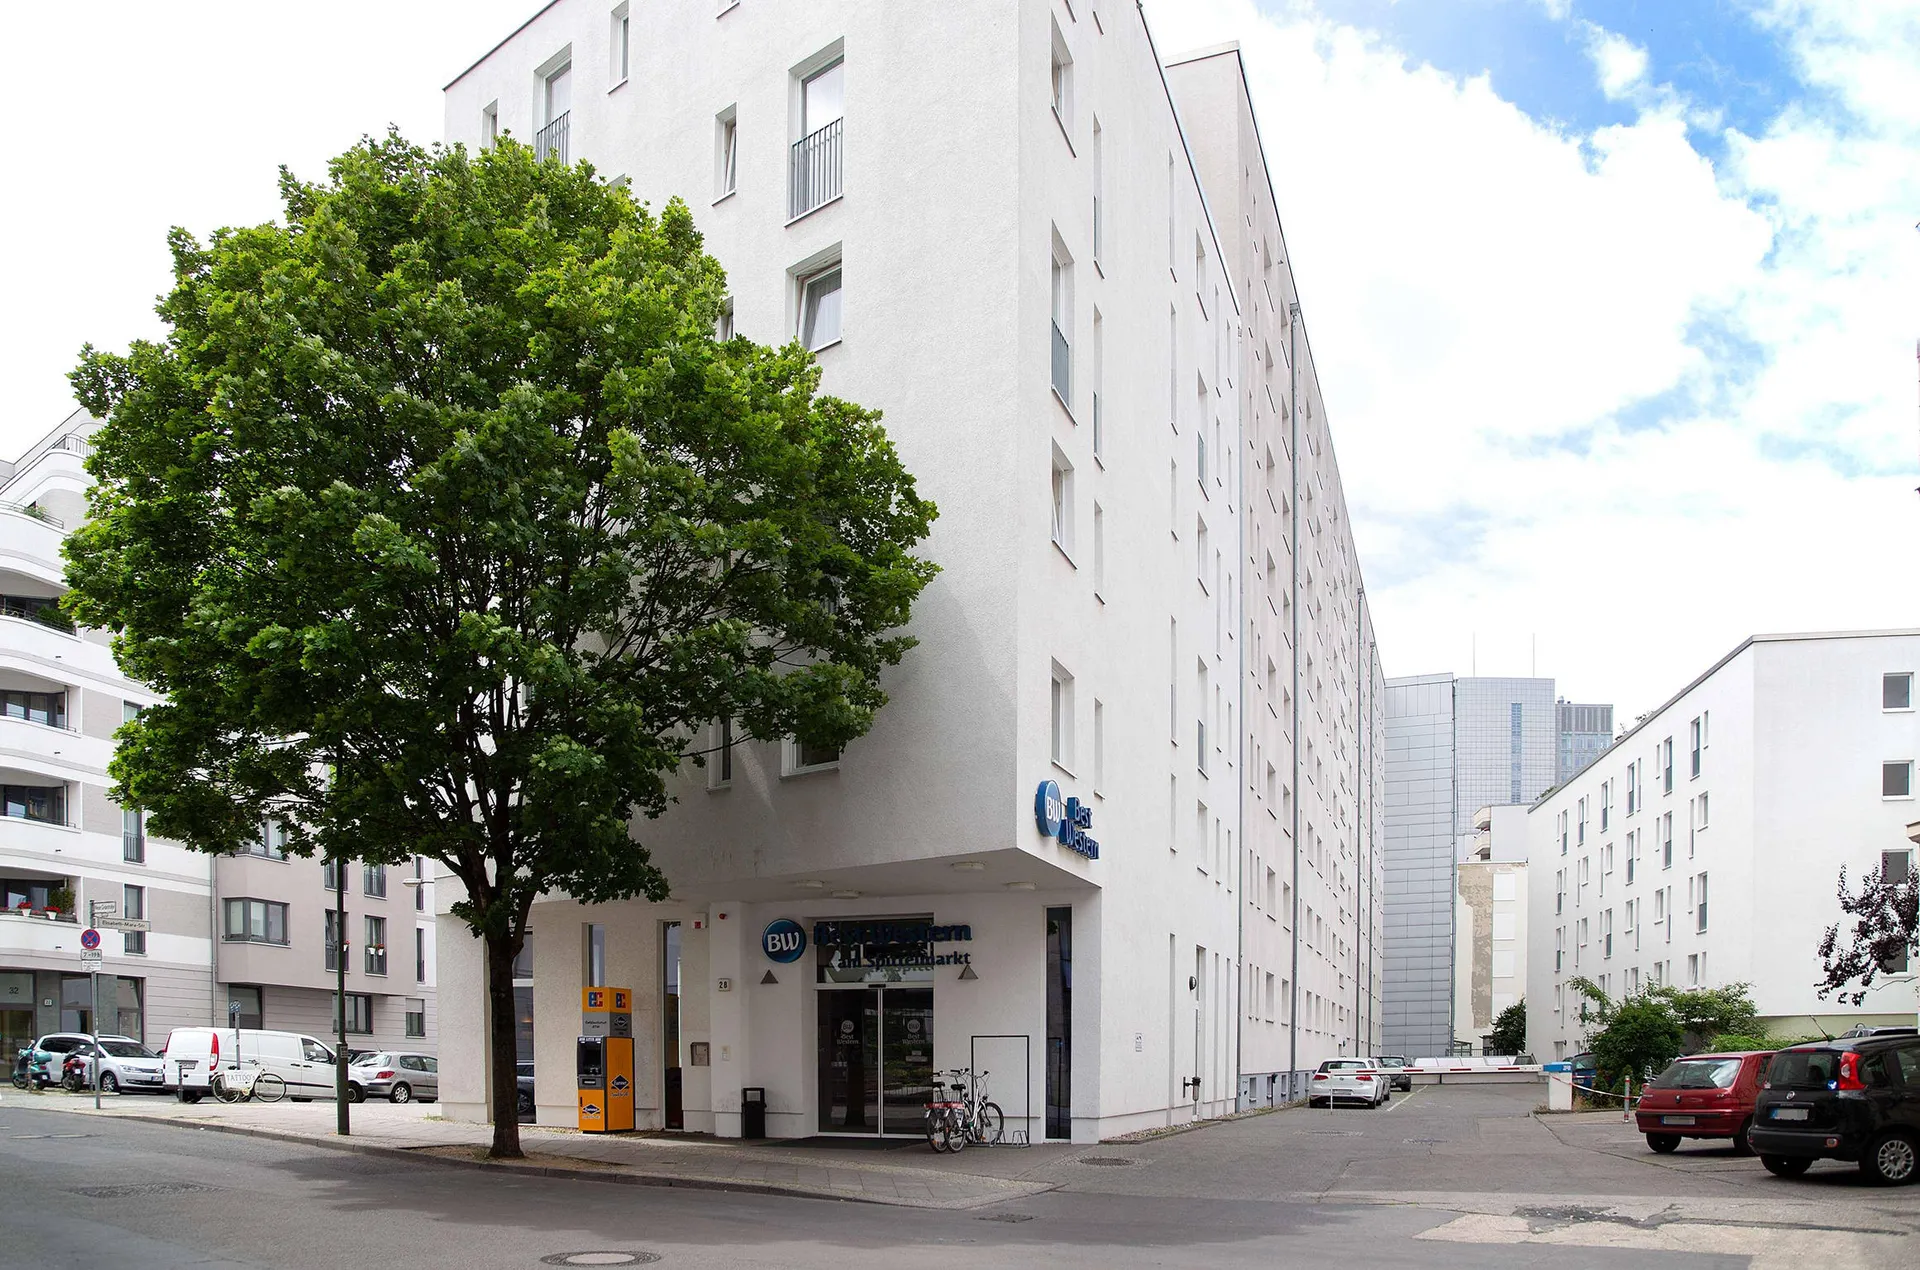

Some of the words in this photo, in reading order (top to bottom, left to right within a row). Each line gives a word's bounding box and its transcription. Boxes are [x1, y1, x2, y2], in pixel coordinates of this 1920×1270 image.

[1046, 796, 1061, 823] BW
[1069, 797, 1093, 829] Best
[1062, 820, 1100, 859] Western
[766, 931, 801, 953] BW
[813, 922, 866, 947] Best
[873, 922, 972, 945] Western
[8, 986, 19, 995] 32
[718, 981, 728, 989] 28
